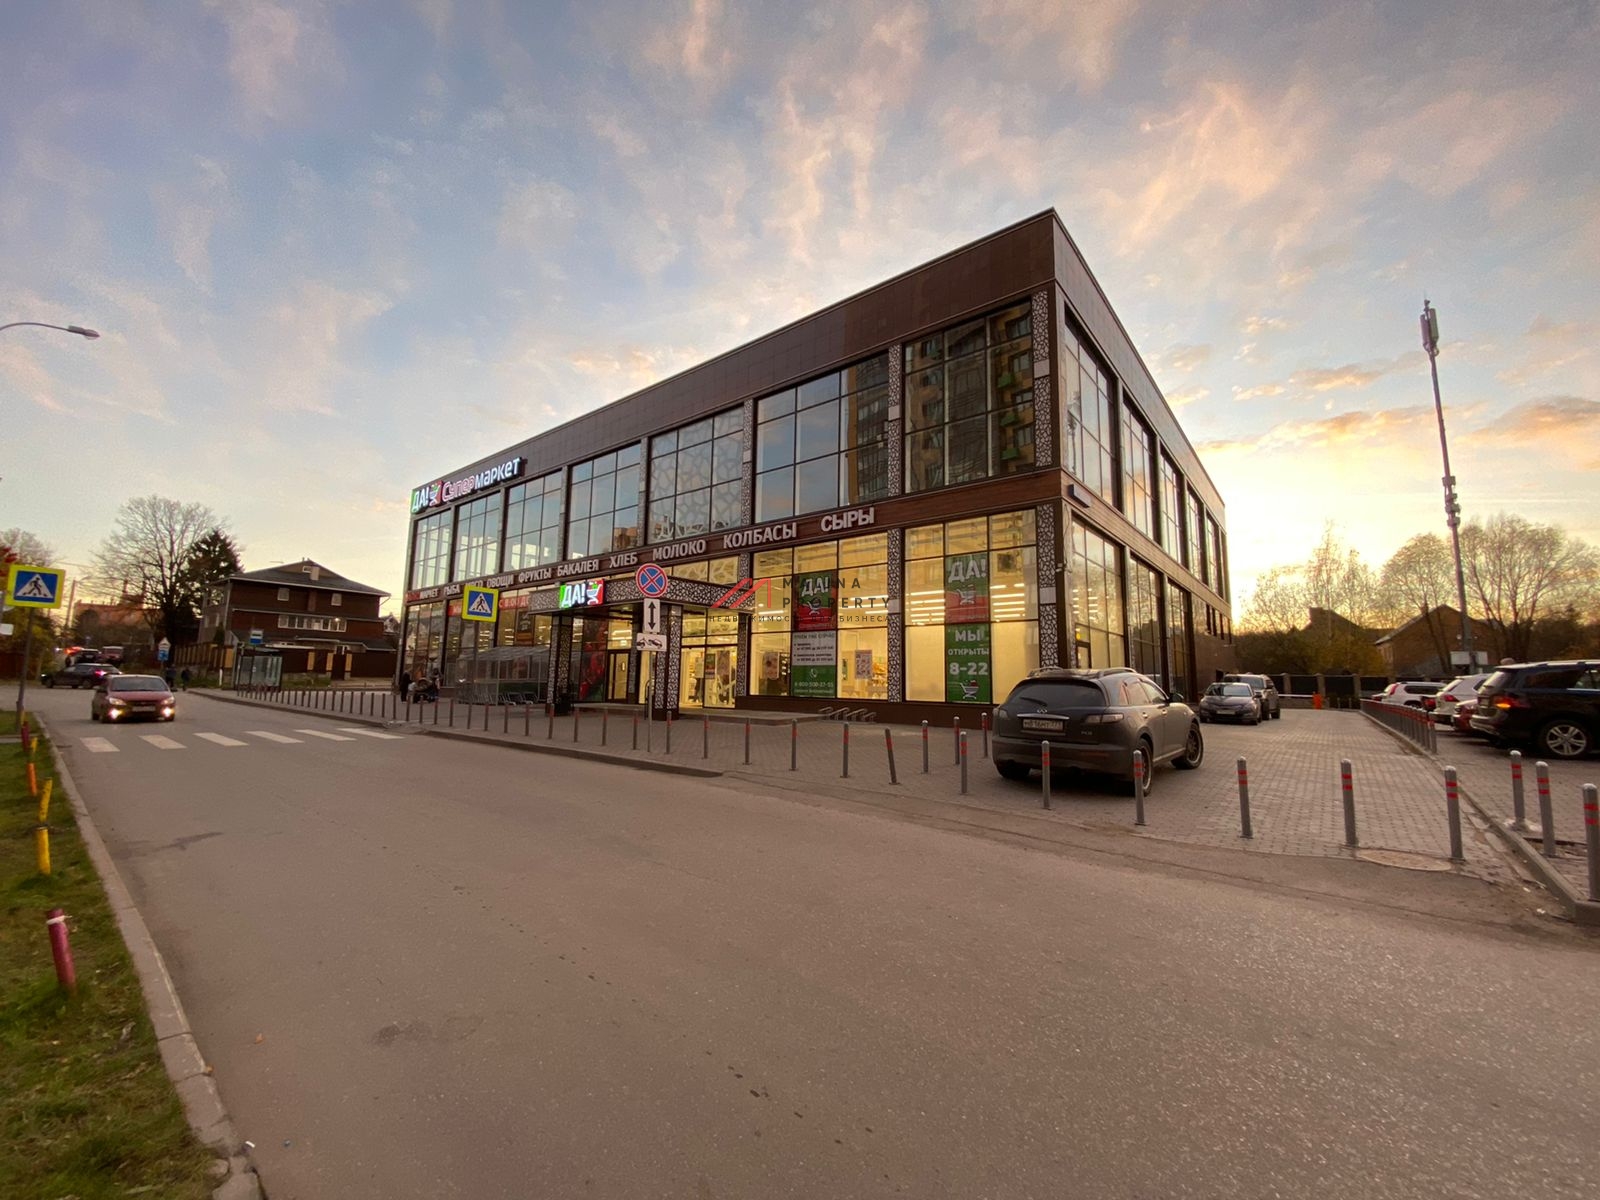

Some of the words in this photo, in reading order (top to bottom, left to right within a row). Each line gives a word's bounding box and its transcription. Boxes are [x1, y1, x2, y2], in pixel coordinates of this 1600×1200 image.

[412, 486, 429, 513] ДА!
[444, 584, 460, 595] РЫБА
[487, 574, 514, 588] ОВОЩИ
[518, 567, 552, 583] ФРУКТЫ
[557, 559, 599, 577] БАКАЛЕЯ
[609, 551, 638, 568] ХЛЕБ
[652, 539, 706, 561] МОЛОКО
[723, 521, 797, 549] КОЛБАСЫ
[820, 507, 875, 532] СЫРЫ
[948, 558, 987, 583] ДА!
[561, 582, 586, 608] ДА!
[801, 576, 829, 597] ДА!
[955, 629, 981, 642] МЫ
[948, 648, 989, 656] ОТКРЫТЫ
[949, 662, 989, 676] 8-22
